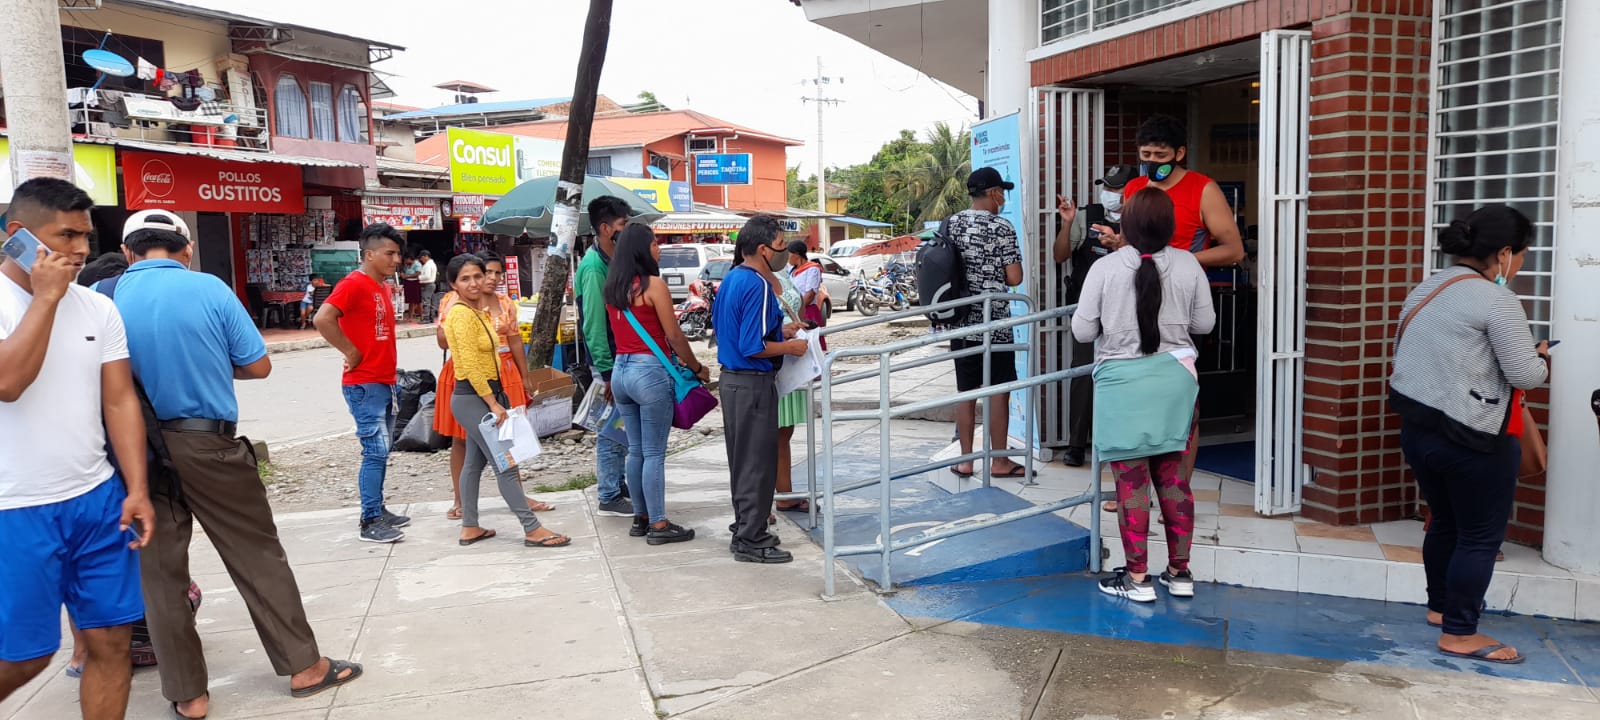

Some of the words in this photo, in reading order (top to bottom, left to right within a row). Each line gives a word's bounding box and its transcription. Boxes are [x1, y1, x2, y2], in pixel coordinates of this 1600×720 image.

[453, 138, 511, 168] Consul
[537, 159, 561, 168] COMERC
[218, 171, 262, 183] POLLOS
[461, 172, 477, 182] Bien
[477, 174, 506, 184] pensado
[198, 183, 282, 202] GUSTITOS
[650, 222, 691, 230] PRESIONES
